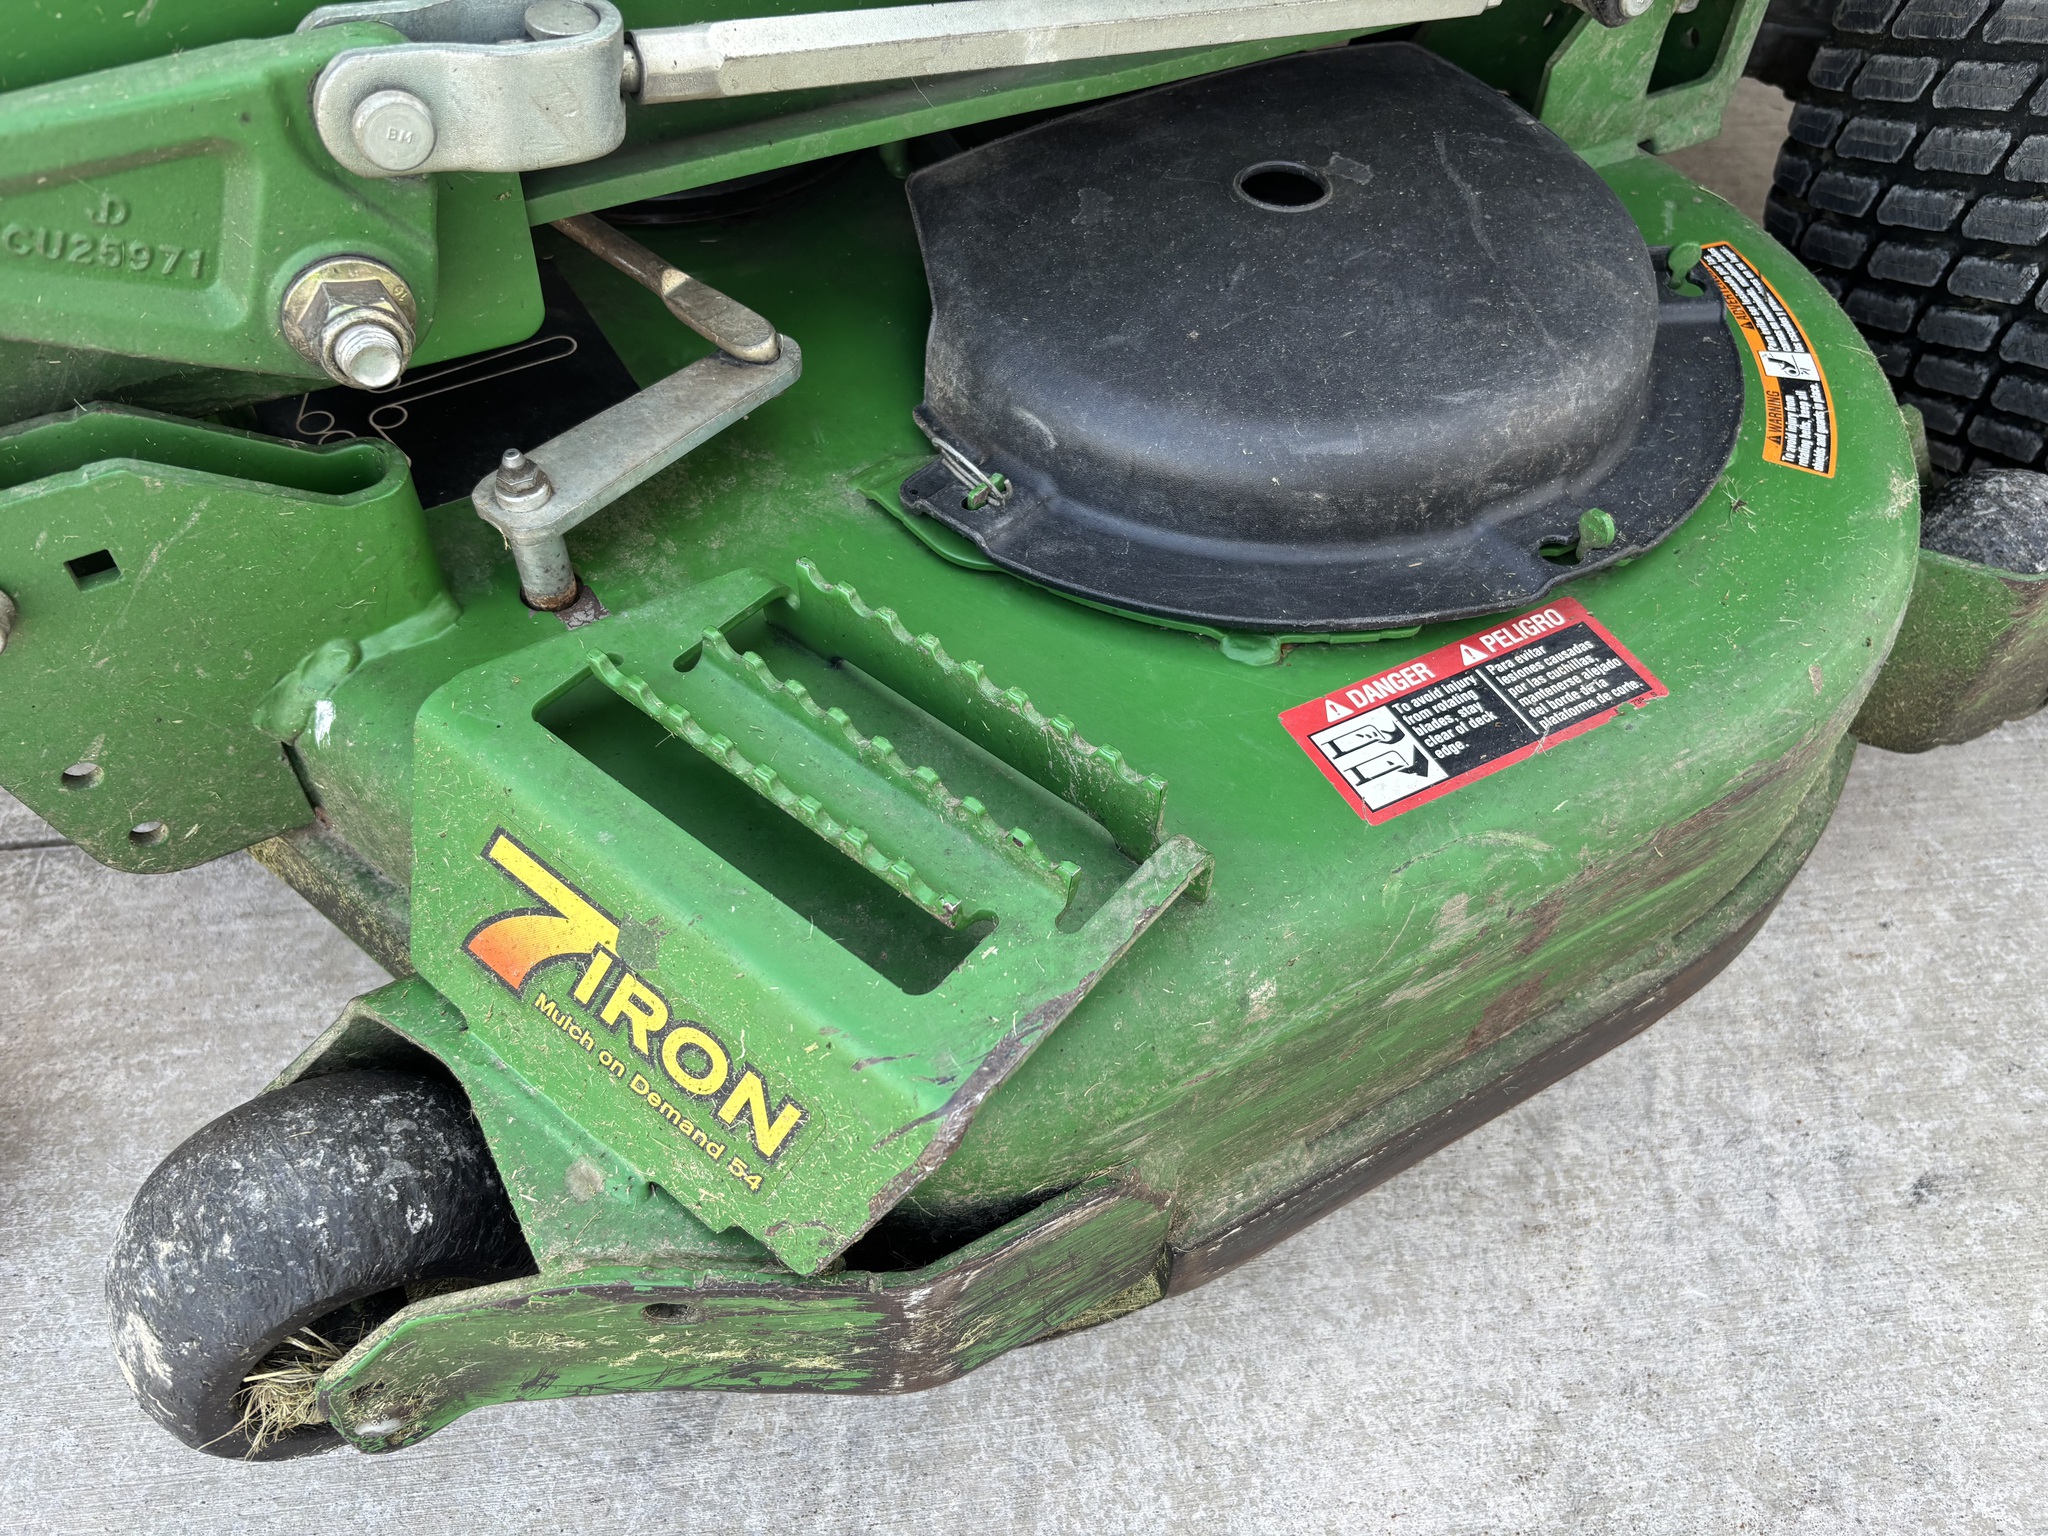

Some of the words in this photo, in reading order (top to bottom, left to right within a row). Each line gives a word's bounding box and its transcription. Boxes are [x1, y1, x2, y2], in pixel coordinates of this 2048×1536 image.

[1703, 254, 1718, 266] las
[1746, 305, 1760, 316] ser
[1754, 316, 1772, 335] evitar
[1765, 335, 1780, 352] Para
[1792, 342, 1805, 353] los
[1785, 395, 1798, 412] from
[1795, 390, 1808, 401] all
[1766, 390, 1782, 433] WARNING
[1784, 411, 1800, 434] injury
[1799, 401, 1813, 419] keep
[1812, 411, 1828, 434] guards
[1785, 433, 1798, 452] avoid
[1799, 418, 1814, 440] belts,
[1813, 433, 1827, 447] and
[1781, 451, 1795, 463] To
[1798, 439, 1813, 467] rotating
[1812, 446, 1827, 472] shields
[1478, 608, 1566, 653] PELIGRO
[1485, 659, 1515, 676] Para
[1514, 645, 1547, 665] evitar
[1496, 661, 1545, 686] lesiones
[1543, 640, 1594, 667] causadas
[1345, 662, 1436, 709] DANGER
[1507, 682, 1529, 699] por
[1528, 674, 1547, 689] las
[1546, 652, 1600, 681] cuchillas,
[1517, 671, 1582, 708] mantenerse
[1582, 657, 1623, 681] alejado
[1392, 702, 1412, 715] To
[1410, 687, 1443, 708] avoid
[1442, 674, 1478, 696] injury
[1402, 710, 1434, 726] from
[1433, 689, 1480, 714] rotating
[1528, 702, 1549, 718] del
[1548, 689, 1581, 710] borde
[1579, 681, 1597, 697] de
[1594, 678, 1609, 690] la
[1539, 697, 1599, 730] plataforma
[1596, 690, 1612, 704] de
[1610, 680, 1644, 698] corte.
[1412, 713, 1460, 737] blades,
[1457, 702, 1485, 718] stay
[1424, 727, 1455, 748] clear
[1454, 721, 1470, 735] of
[1468, 710, 1499, 730] deck
[1434, 743, 1470, 759] edge.
[569, 946, 808, 1162] IRON
[533, 992, 596, 1052] Mulch
[598, 1048, 626, 1080] on
[628, 1071, 728, 1161] Demand
[727, 1156, 765, 1193] 54
